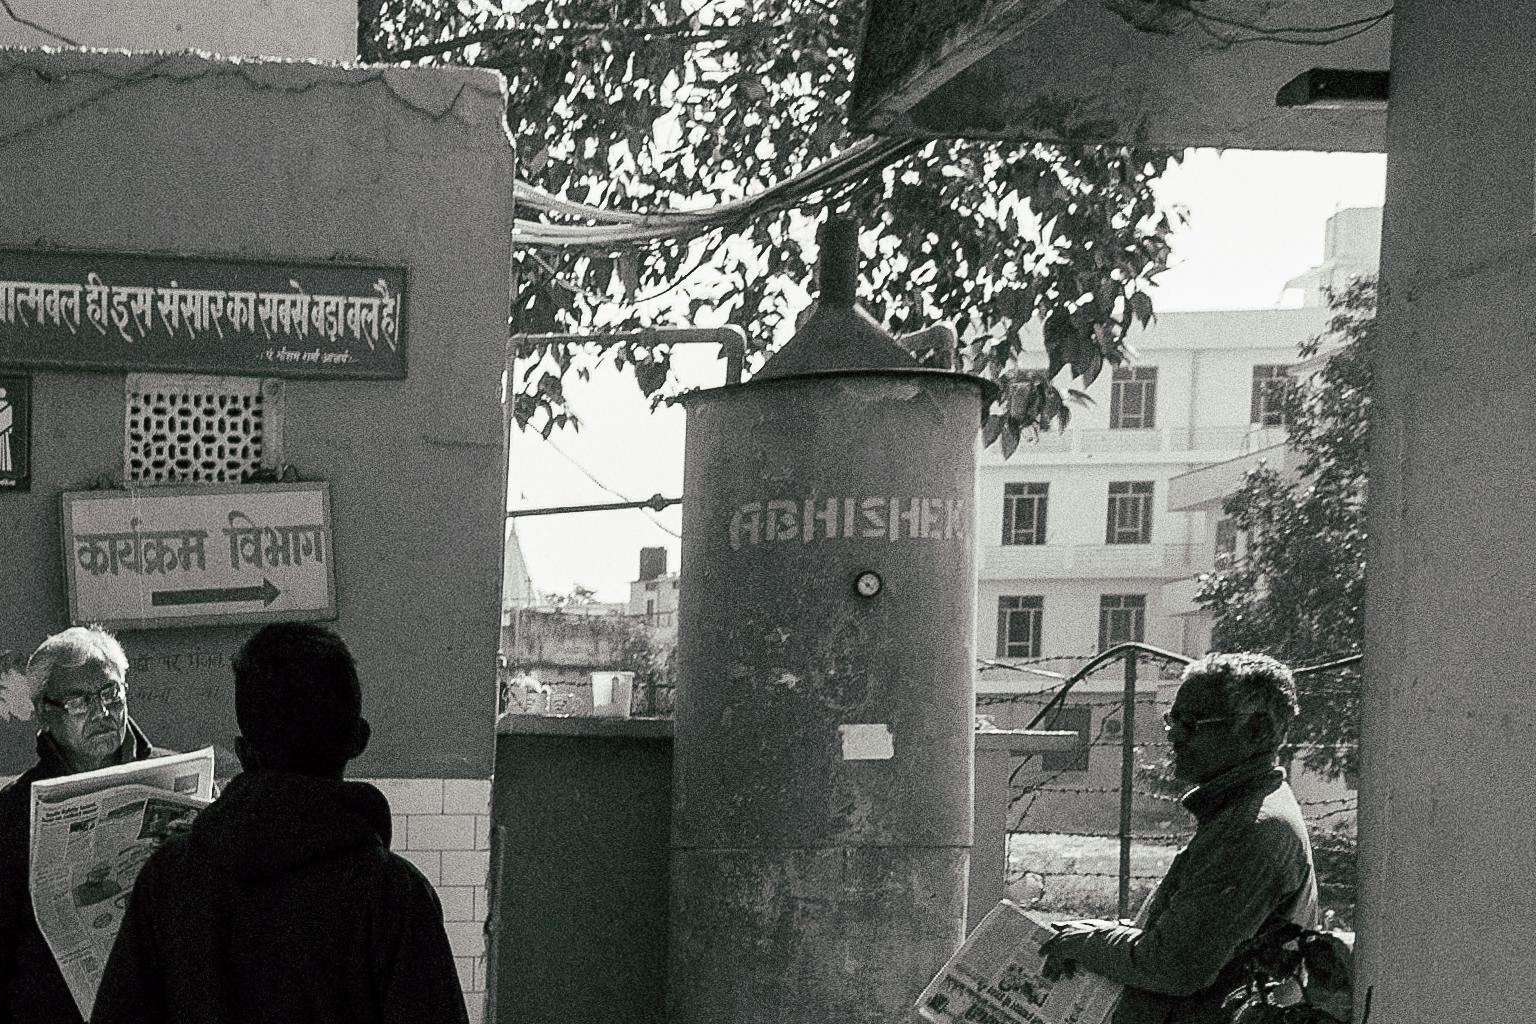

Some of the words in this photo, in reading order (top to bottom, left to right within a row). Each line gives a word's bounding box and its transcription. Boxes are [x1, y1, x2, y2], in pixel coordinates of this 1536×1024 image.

[84, 271, 109, 335] ही
[110, 285, 155, 343] इस
[156, 280, 228, 339] संसार
[227, 290, 257, 333] का
[259, 279, 312, 340] सबसे
[311, 294, 347, 343] बड़ा
[347, 295, 381, 351] बल
[75, 516, 210, 577] कार्यक्रम
[222, 509, 326, 570] विभाग
[728, 496, 966, 551] ABHISHEK
